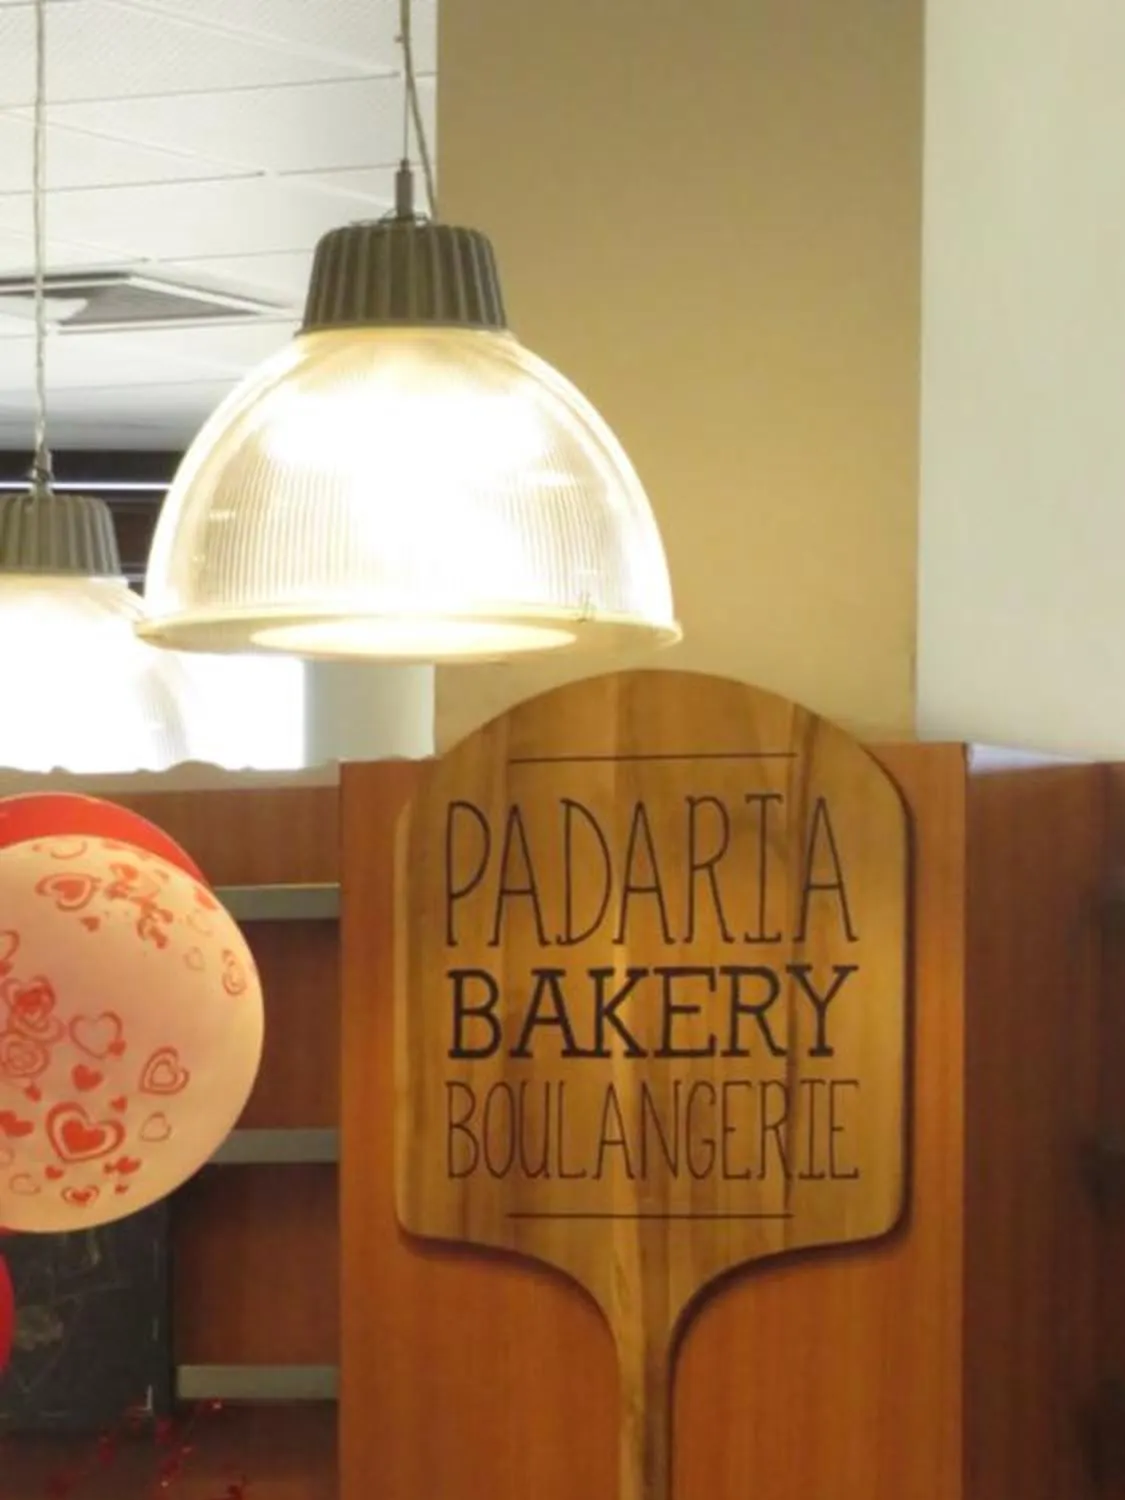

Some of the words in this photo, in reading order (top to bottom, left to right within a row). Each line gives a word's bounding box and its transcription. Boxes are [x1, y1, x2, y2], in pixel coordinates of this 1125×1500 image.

[445, 794, 859, 947] PADARIA
[446, 964, 859, 1059] BAKERY
[445, 1078, 860, 1181] BOULANGERIE
